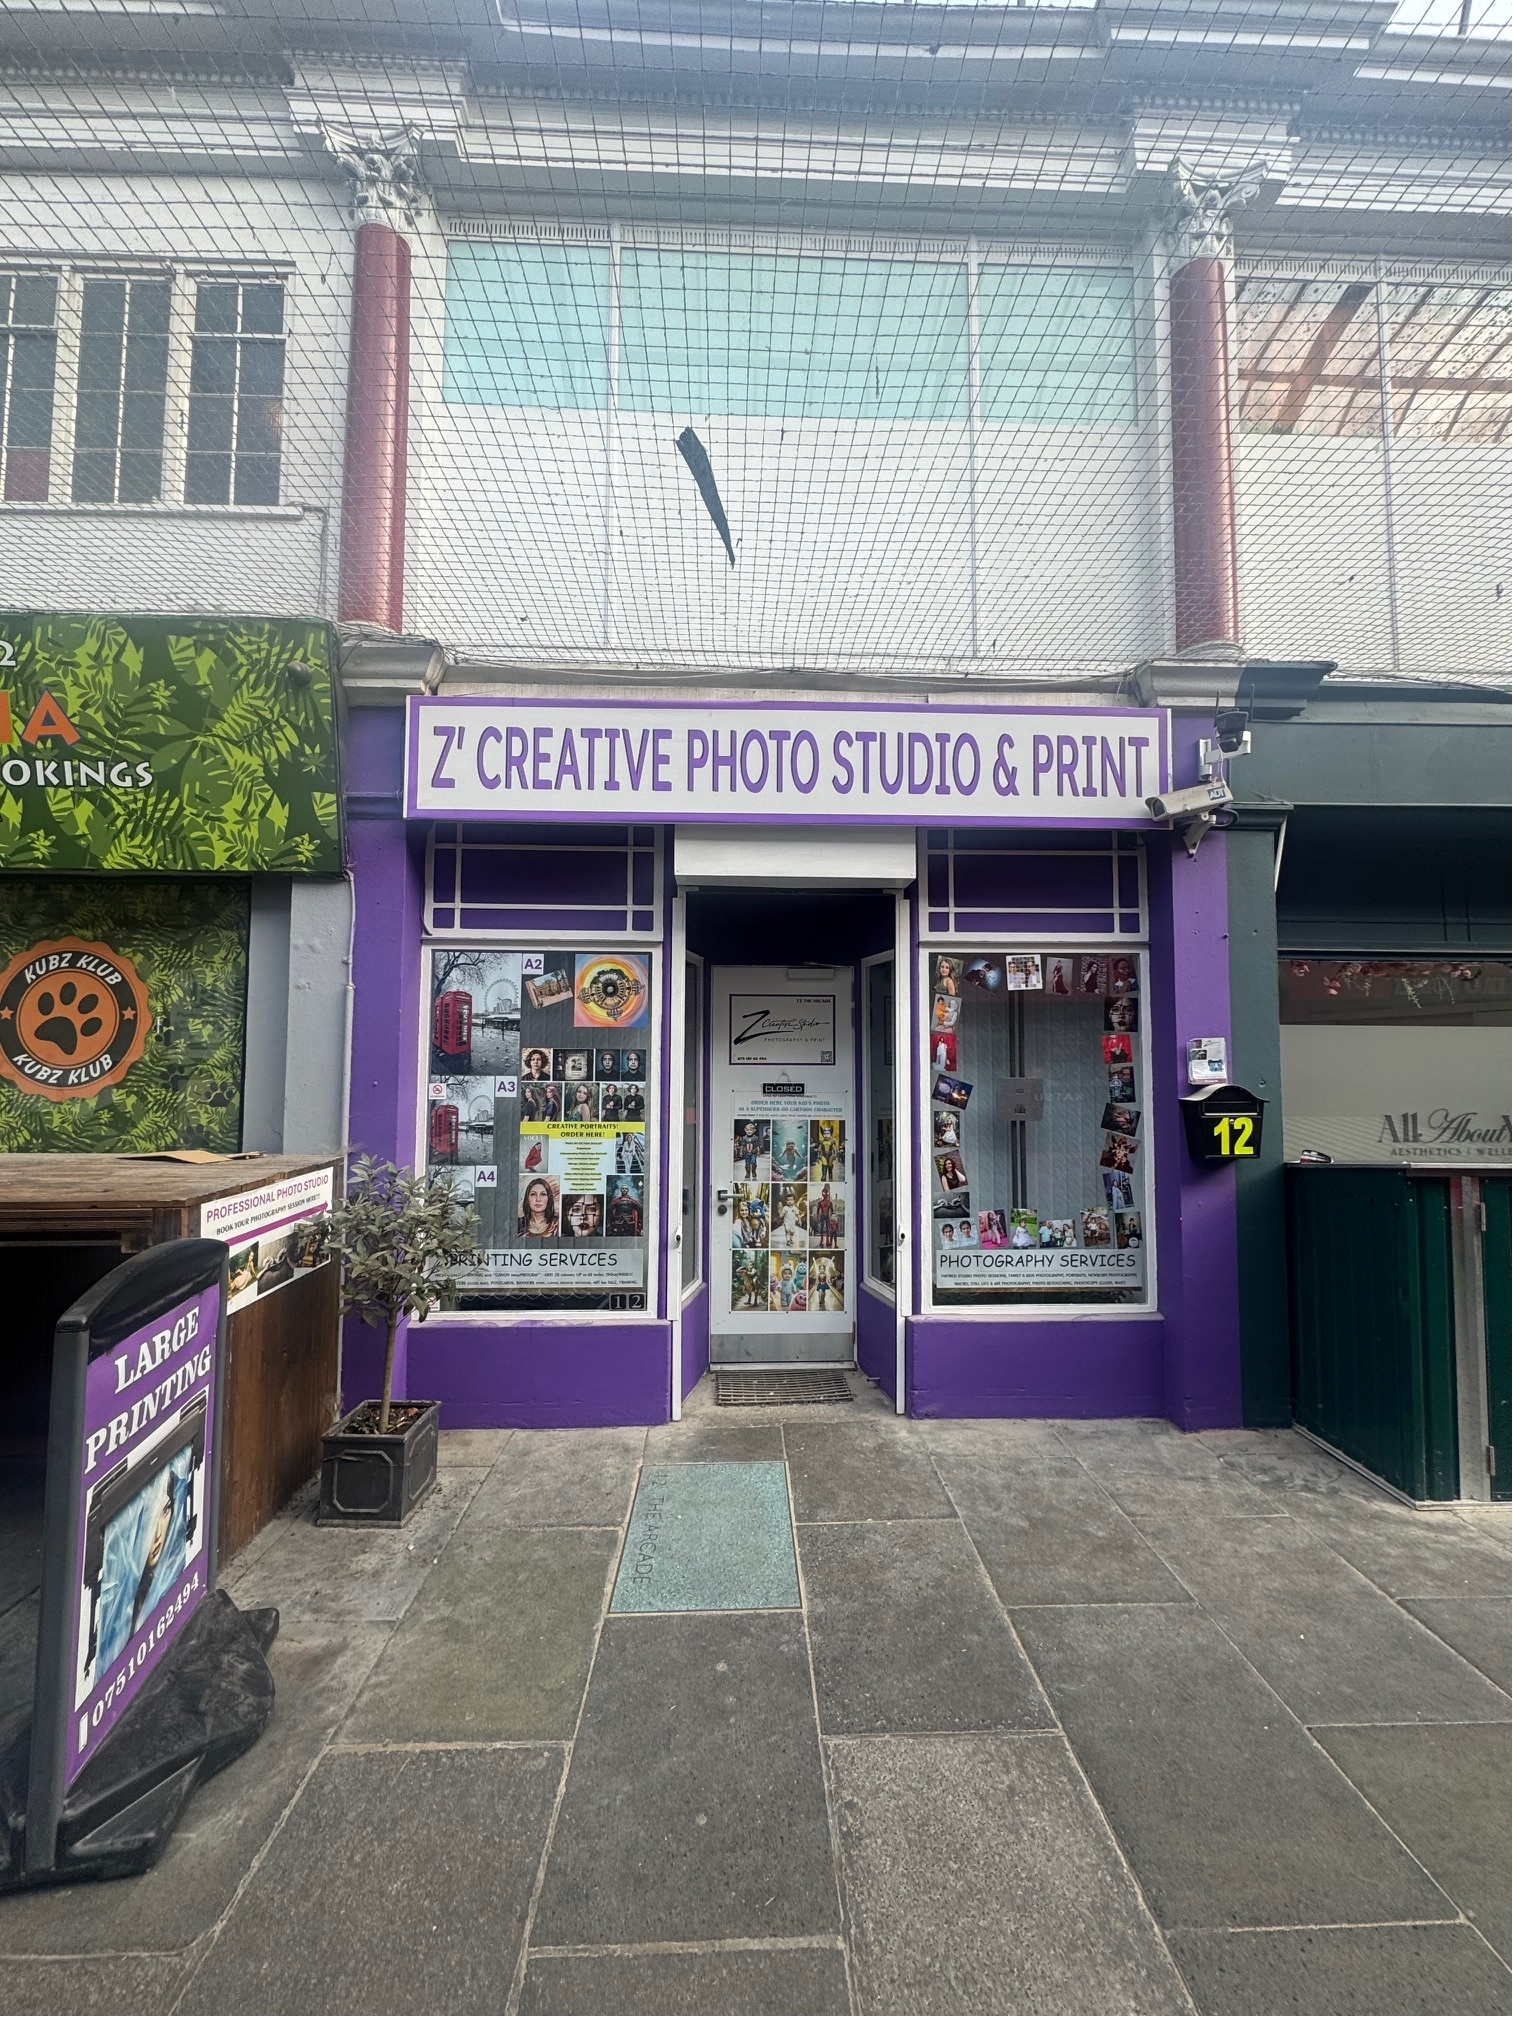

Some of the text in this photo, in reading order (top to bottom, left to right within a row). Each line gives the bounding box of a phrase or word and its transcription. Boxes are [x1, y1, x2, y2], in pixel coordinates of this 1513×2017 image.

[431, 726, 1150, 798] Z' CREATIVE PHOTO STUDIO & PRINT
[1210, 789, 1225, 799] ADT
[24, 953, 123, 985] KUBZ KLUB
[524, 958, 543, 970] A2
[12, 1053, 114, 1085] KUBZ KLUB
[497, 1080, 516, 1092] A3
[1213, 1117, 1254, 1155] 12
[1377, 1112, 1420, 1143] All
[1419, 1108, 1507, 1144] About
[1391, 1148, 1461, 1156] AESTHETICS
[477, 1171, 496, 1182] A4
[206, 1174, 329, 1223] PROFESSIONAL PHOTO STUDIO
[216, 1223, 234, 1236] BOOK
[234, 1218, 249, 1229] YOUR
[250, 1205, 286, 1224] PHOTOGRAPHY
[288, 1198, 305, 1210] SESSION
[538, 1253, 618, 1266] SERVICES
[940, 1254, 1136, 1268] PHOTOGRAPHY SERVICES
[114, 1306, 200, 1394] LARGE
[84, 1344, 212, 1475] PRINTING
[646, 1496, 665, 1520] THE
[633, 1523, 659, 1585] ARCADE
[92, 1572, 200, 1727] 07510162494
